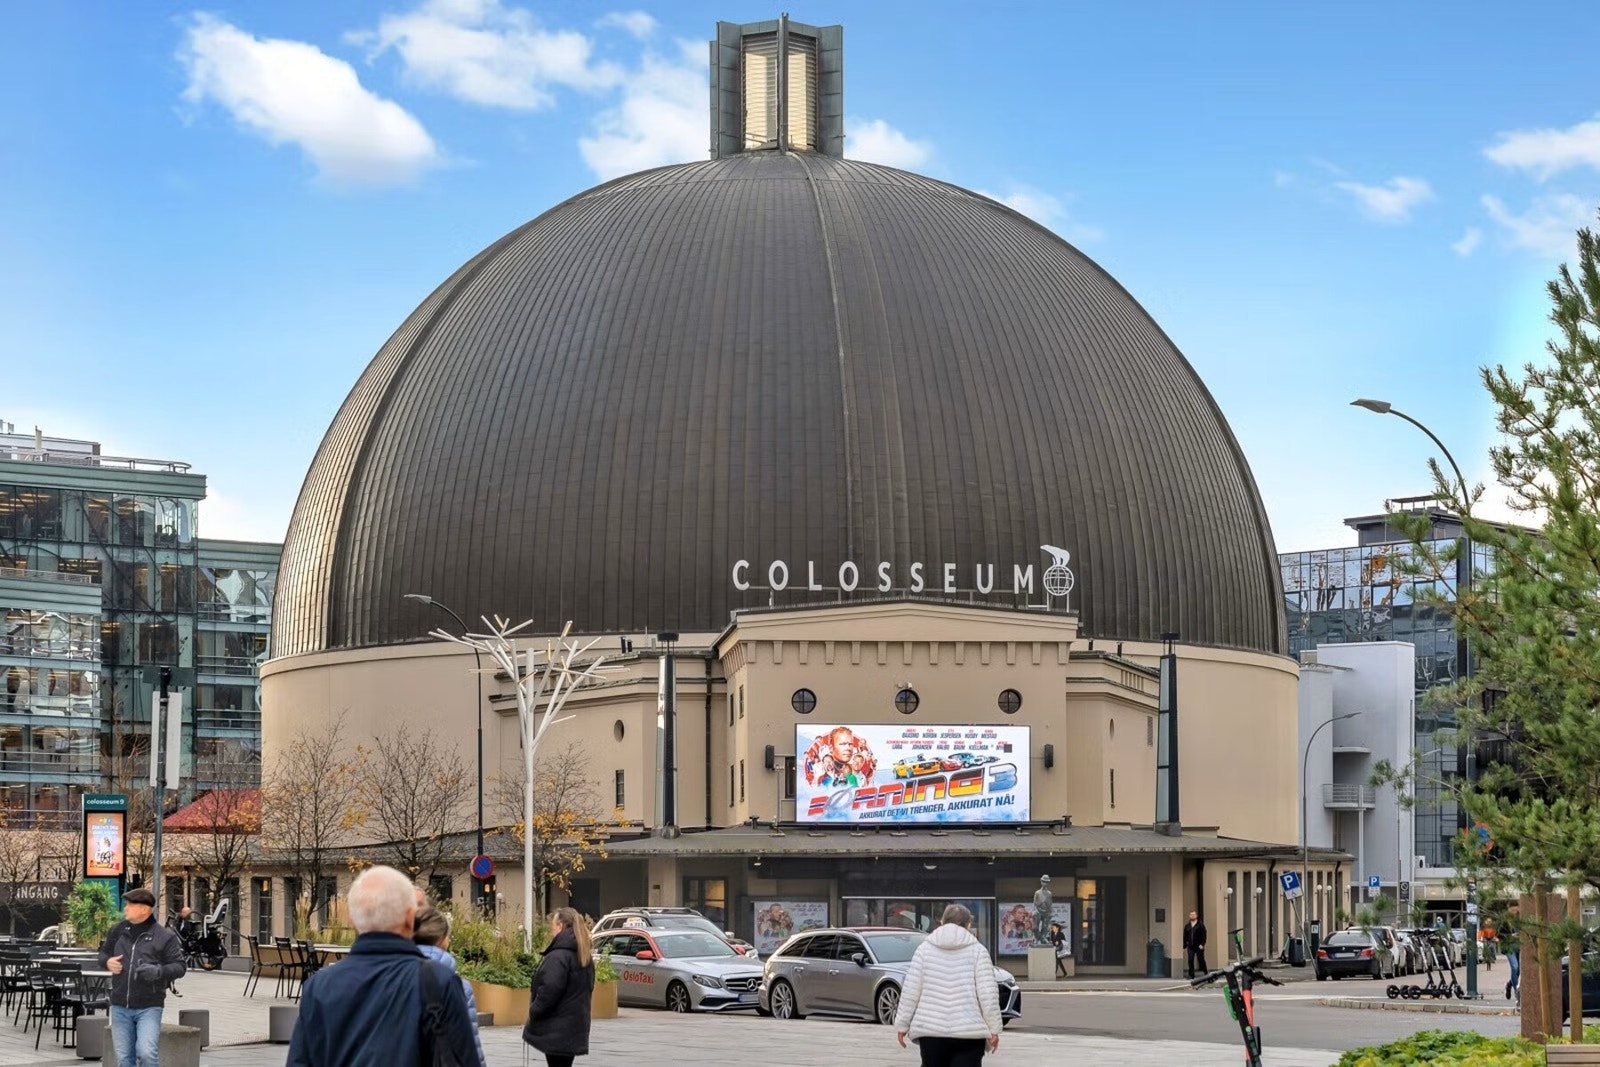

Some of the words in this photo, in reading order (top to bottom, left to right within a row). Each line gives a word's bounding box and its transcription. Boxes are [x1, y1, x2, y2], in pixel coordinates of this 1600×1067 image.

[732, 559, 1034, 595] COLOSSEUM
[988, 762, 1018, 793] 3
[859, 809, 886, 820] AKKURAT
[887, 808, 901, 818] DET
[901, 807, 909, 816] VI
[909, 803, 946, 814] TRENGER.
[947, 798, 992, 812] AKKURAT
[995, 794, 1015, 807] NÅ!
[1283, 874, 1294, 889] P
[1370, 876, 1378, 887] P
[623, 970, 655, 985] OsloTaxi
